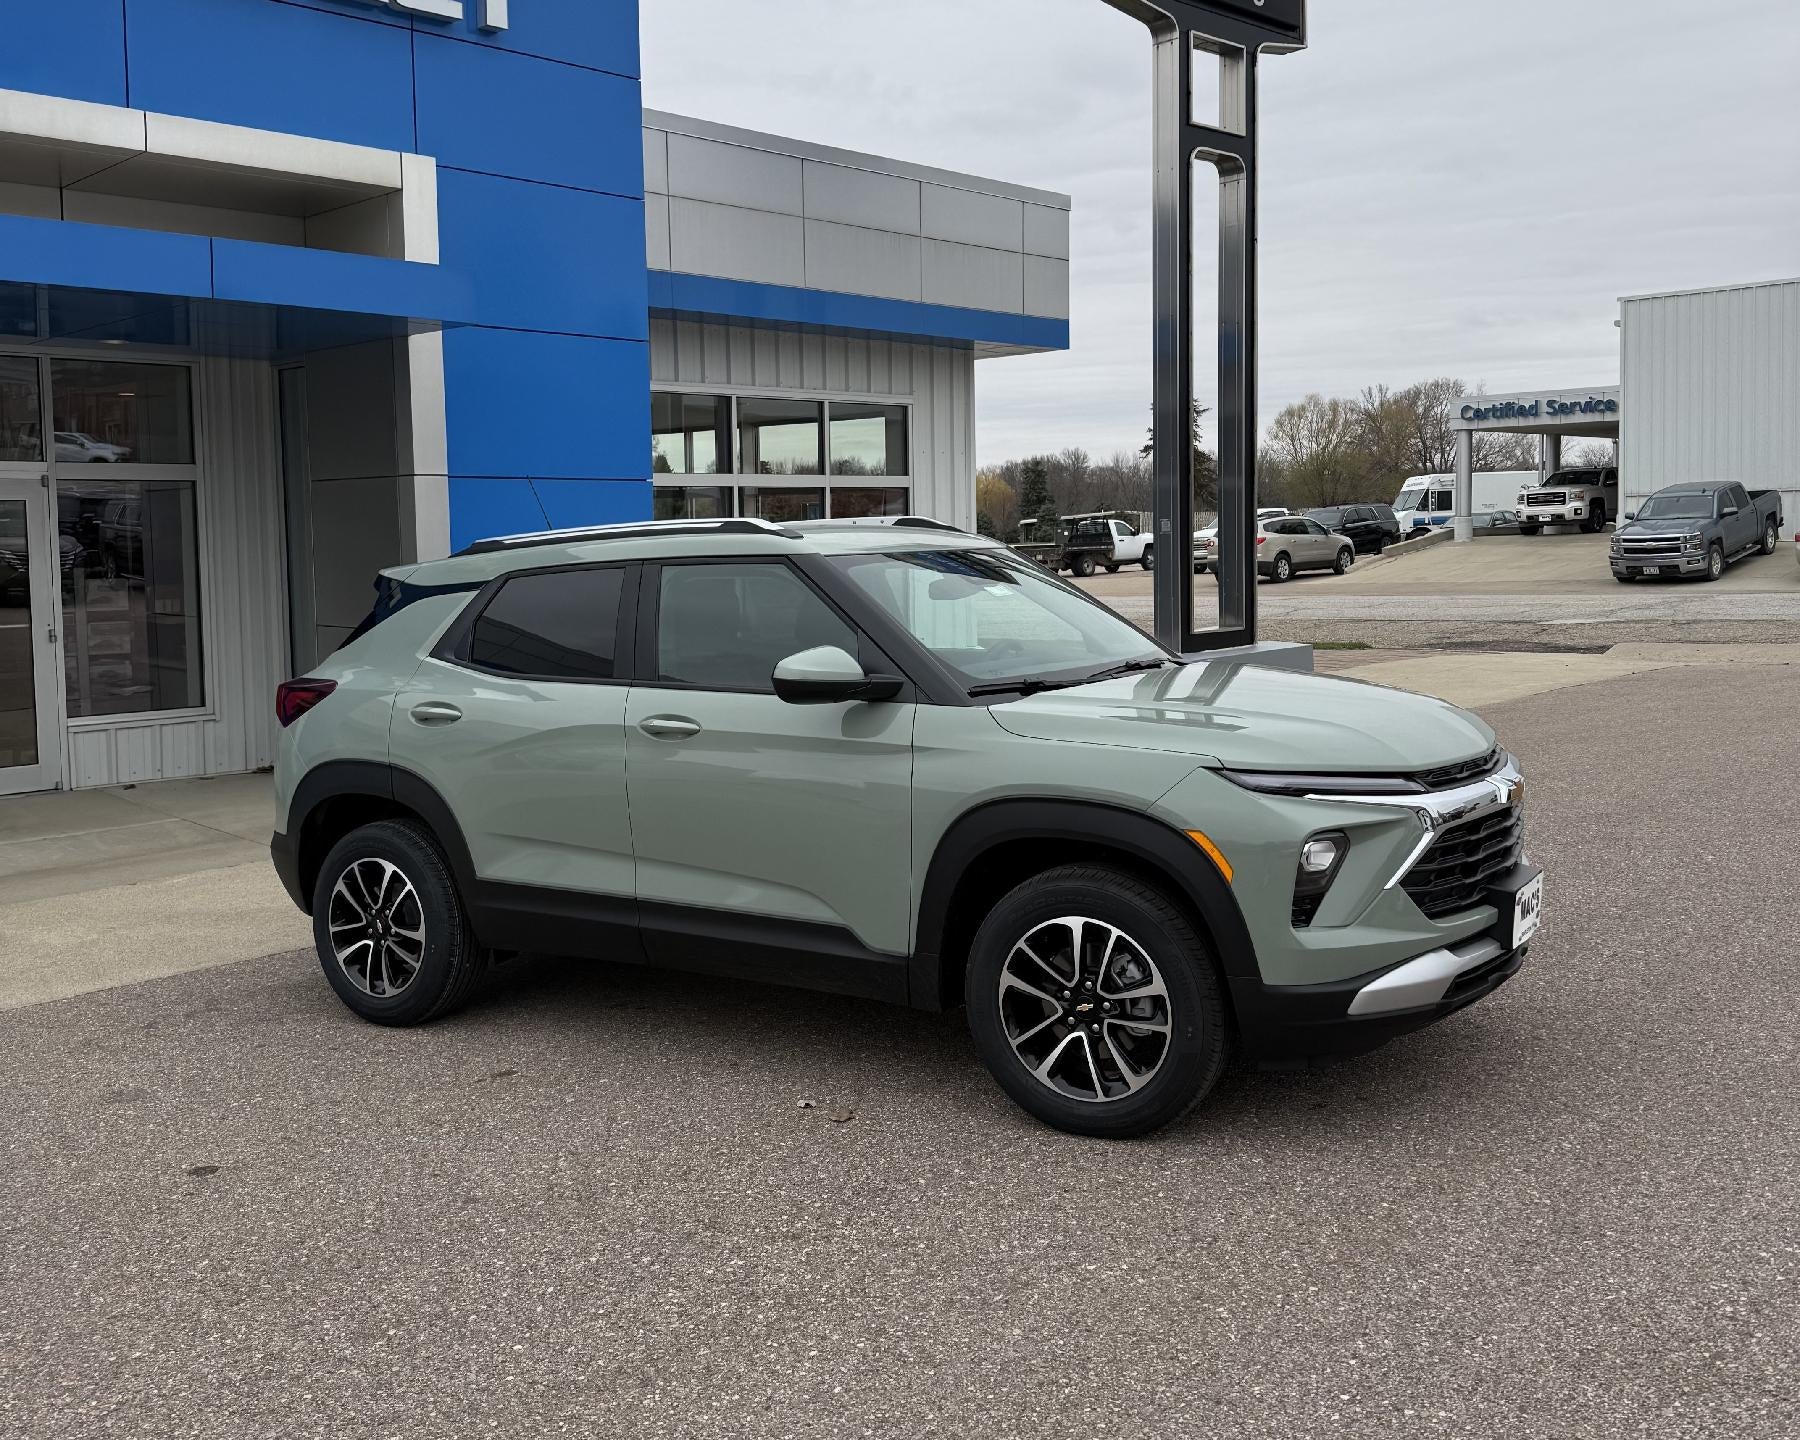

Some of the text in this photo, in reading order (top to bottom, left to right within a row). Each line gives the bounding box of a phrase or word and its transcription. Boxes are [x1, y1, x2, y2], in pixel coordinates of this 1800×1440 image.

[1460, 396, 1617, 421] Certified Service
[1520, 887, 1540, 921] MAC'S
